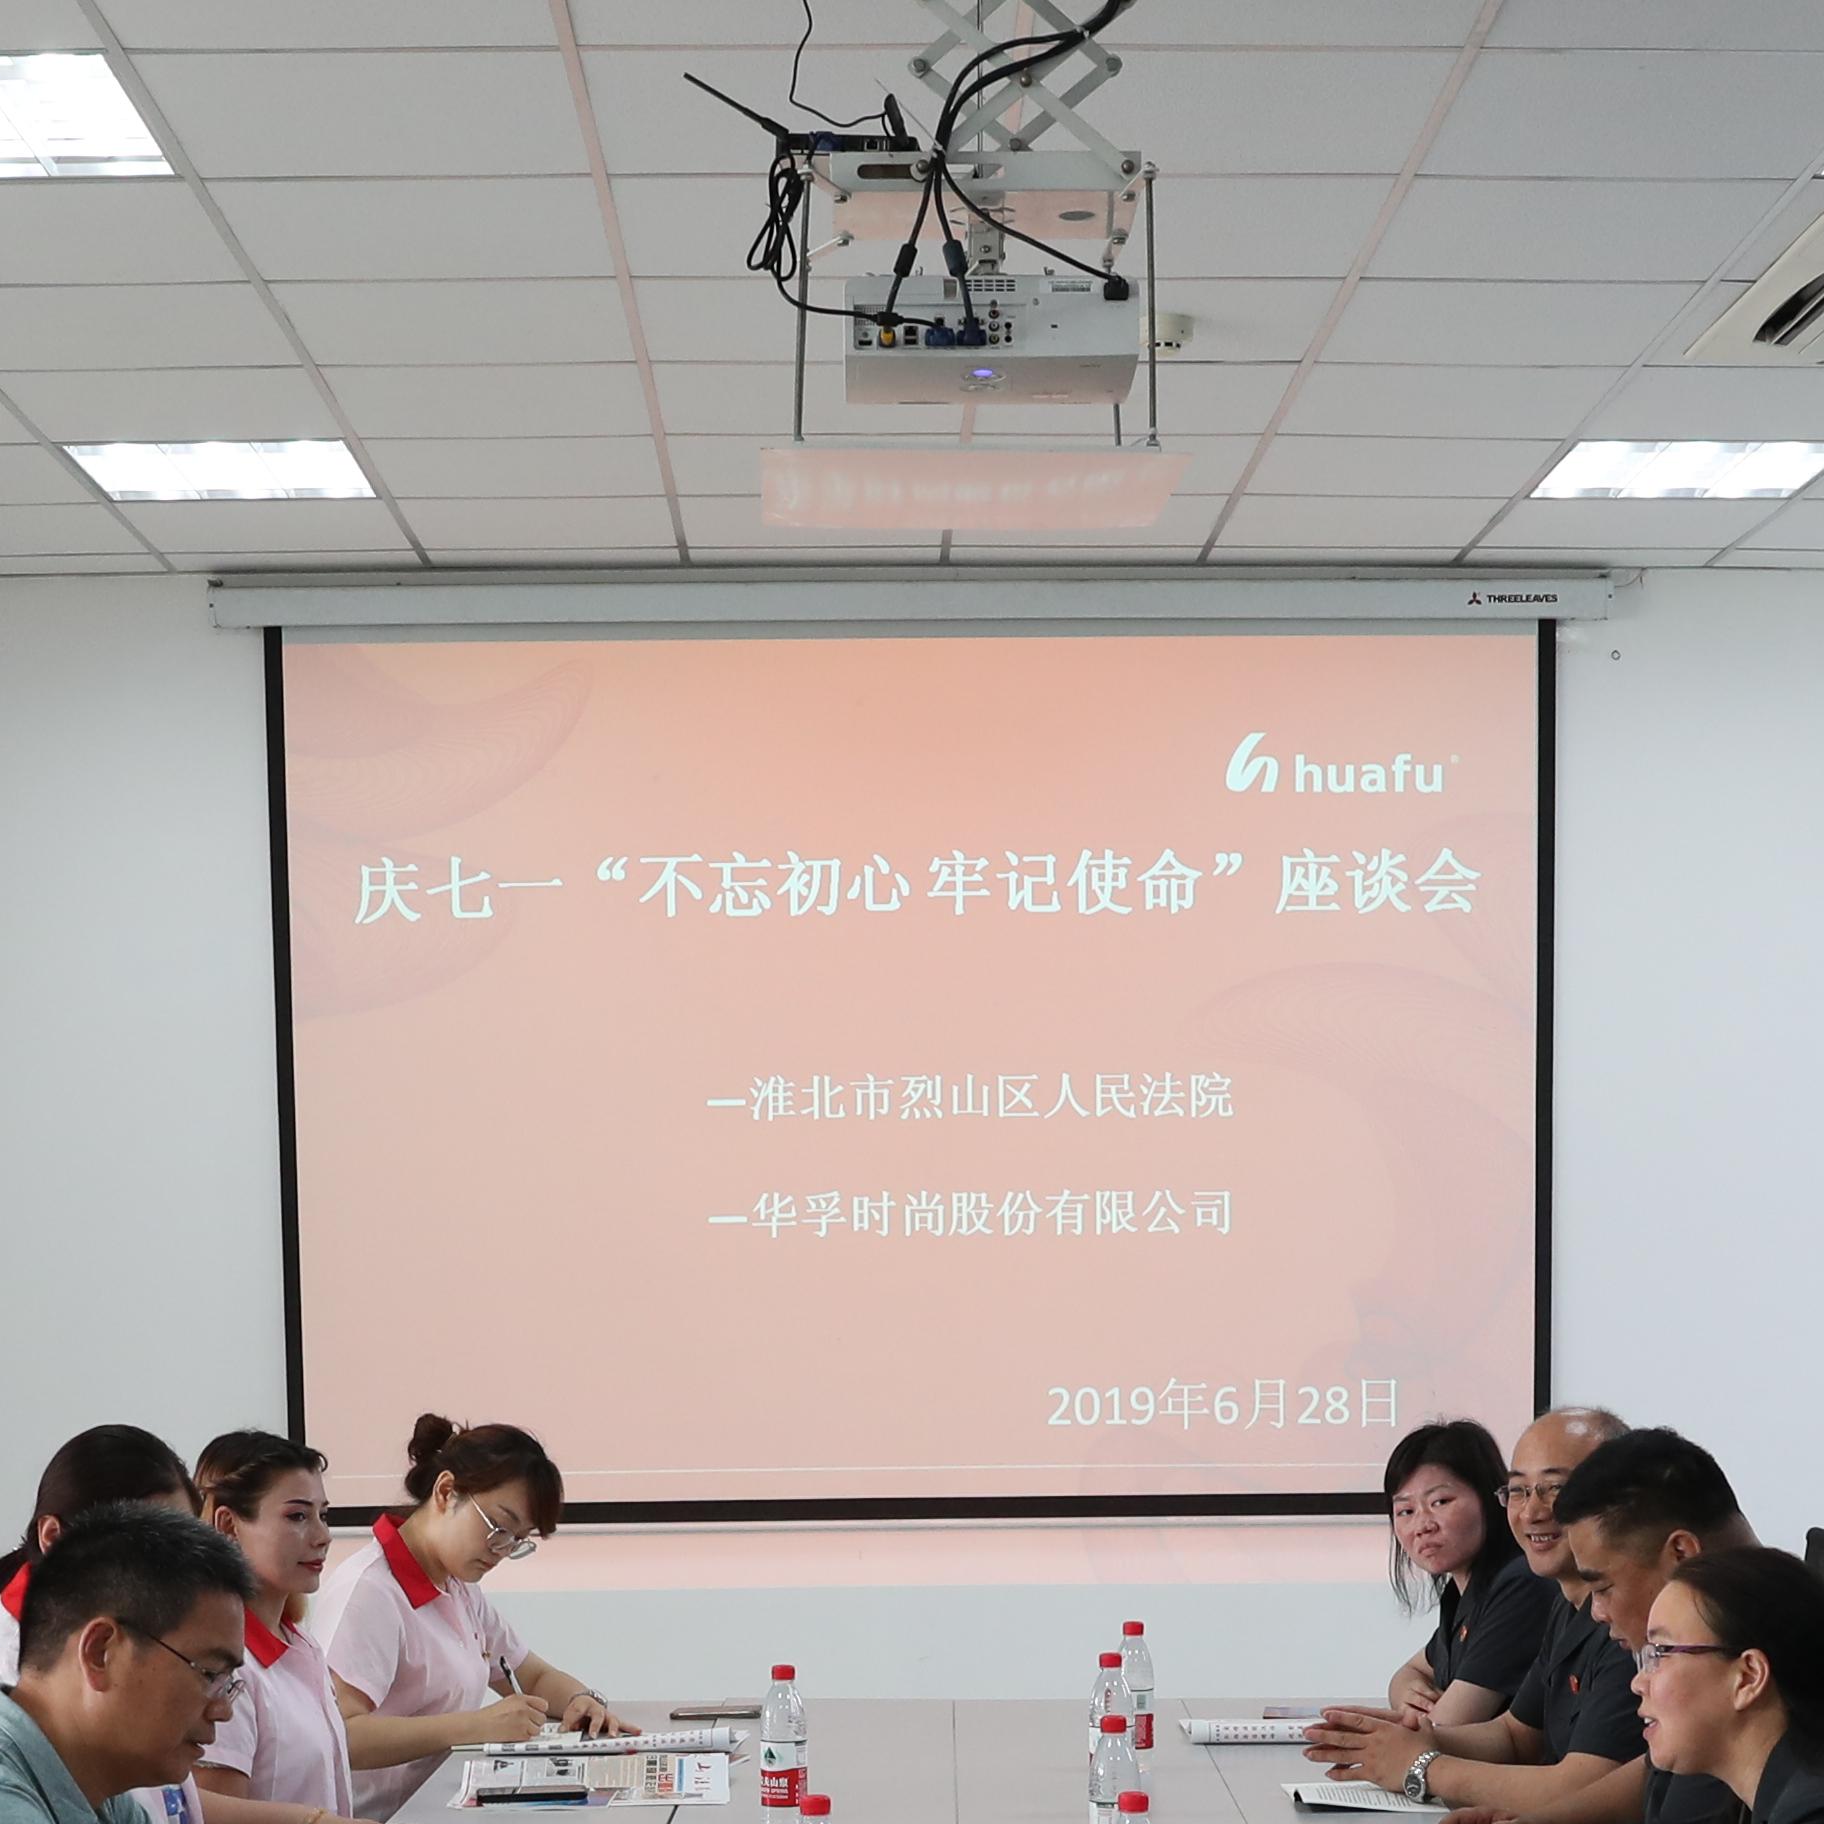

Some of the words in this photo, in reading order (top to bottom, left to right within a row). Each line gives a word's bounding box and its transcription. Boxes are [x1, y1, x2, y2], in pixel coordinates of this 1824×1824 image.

[1486, 594, 1558, 603] THREELEAVES
[1294, 753, 1444, 793] huafu
[1047, 1377, 1398, 1430] 2019年6月28日
